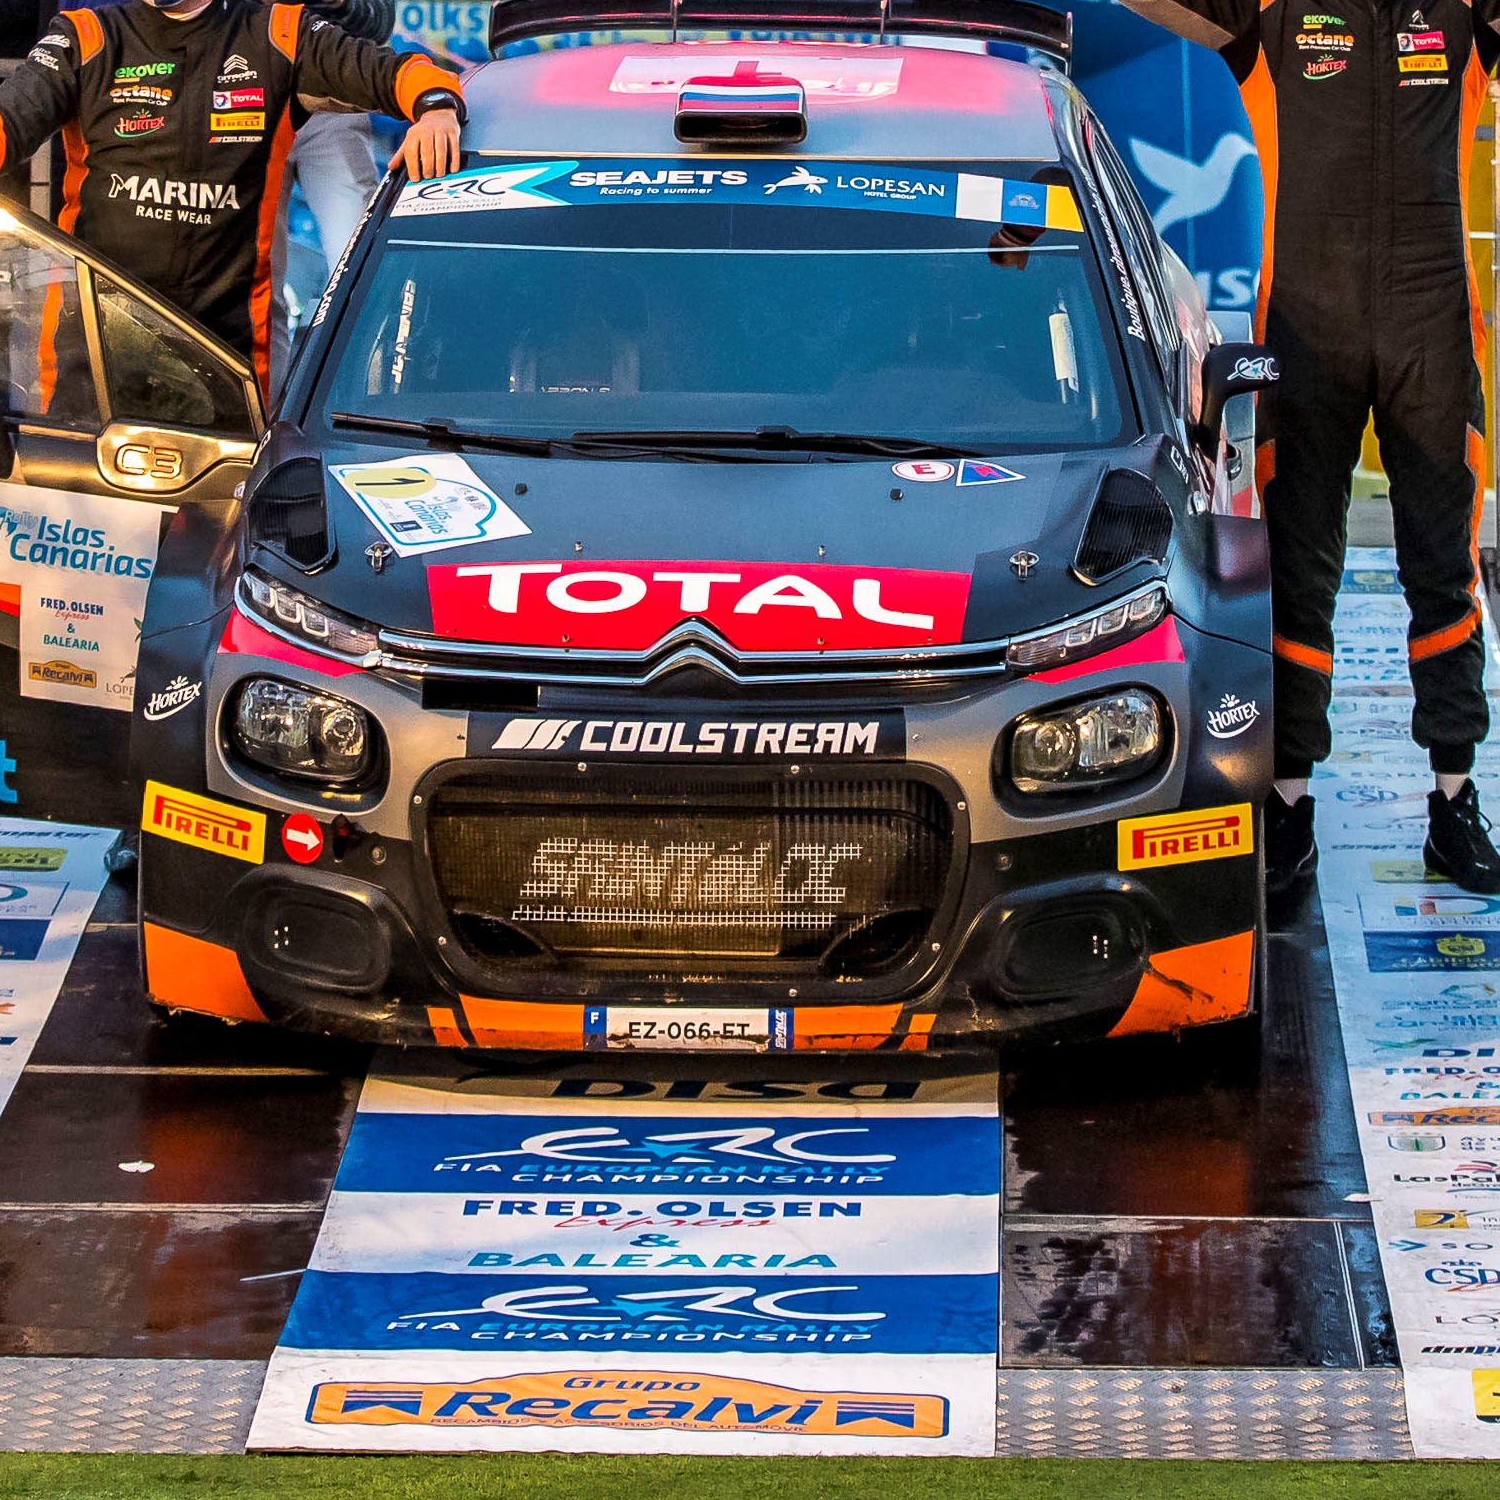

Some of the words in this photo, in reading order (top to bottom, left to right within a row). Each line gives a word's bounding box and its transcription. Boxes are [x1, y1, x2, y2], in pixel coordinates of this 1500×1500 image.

[115, 61, 176, 79] ekover
[109, 85, 173, 102] octane
[231, 94, 263, 104] TOTAL
[117, 115, 165, 134] HORTEX
[570, 169, 749, 189] SEAJETS
[836, 175, 946, 199] LOPESAN
[108, 173, 241, 211] MARINA
[599, 186, 636, 197] Racing
[647, 186, 659, 196] to
[662, 187, 713, 197] summer
[864, 190, 888, 198] HOTEL
[890, 191, 917, 200] GROUP
[136, 205, 172, 222] RACE
[177, 209, 212, 225] WEAR
[115, 443, 183, 480] C3
[37, 515, 107, 549] Islas
[8, 533, 153, 580] Canarias
[456, 563, 936, 631] TOTAL
[42, 634, 100, 652] BALEARIA
[148, 679, 203, 714] HORTEX
[1207, 700, 1261, 733] HORTEX
[580, 721, 879, 756] COOLSTREAM
[153, 793, 252, 852] PIRELLI
[1131, 814, 1242, 860] PIRELLI
[442, 1125, 897, 1164] ERC
[433, 1161, 502, 1173] FIA
[517, 1162, 754, 1176] EUROPEAN
[760, 1163, 890, 1176] RALLY
[510, 1171, 884, 1185] CHAMPIONSHIP
[655, 1200, 863, 1219] OLSEN
[551, 1214, 778, 1232] Express
[629, 1232, 680, 1248] &
[466, 1251, 838, 1269] BALEARIA
[562, 1375, 702, 1394] Grupo
[433, 1391, 824, 1426] Recalvi
